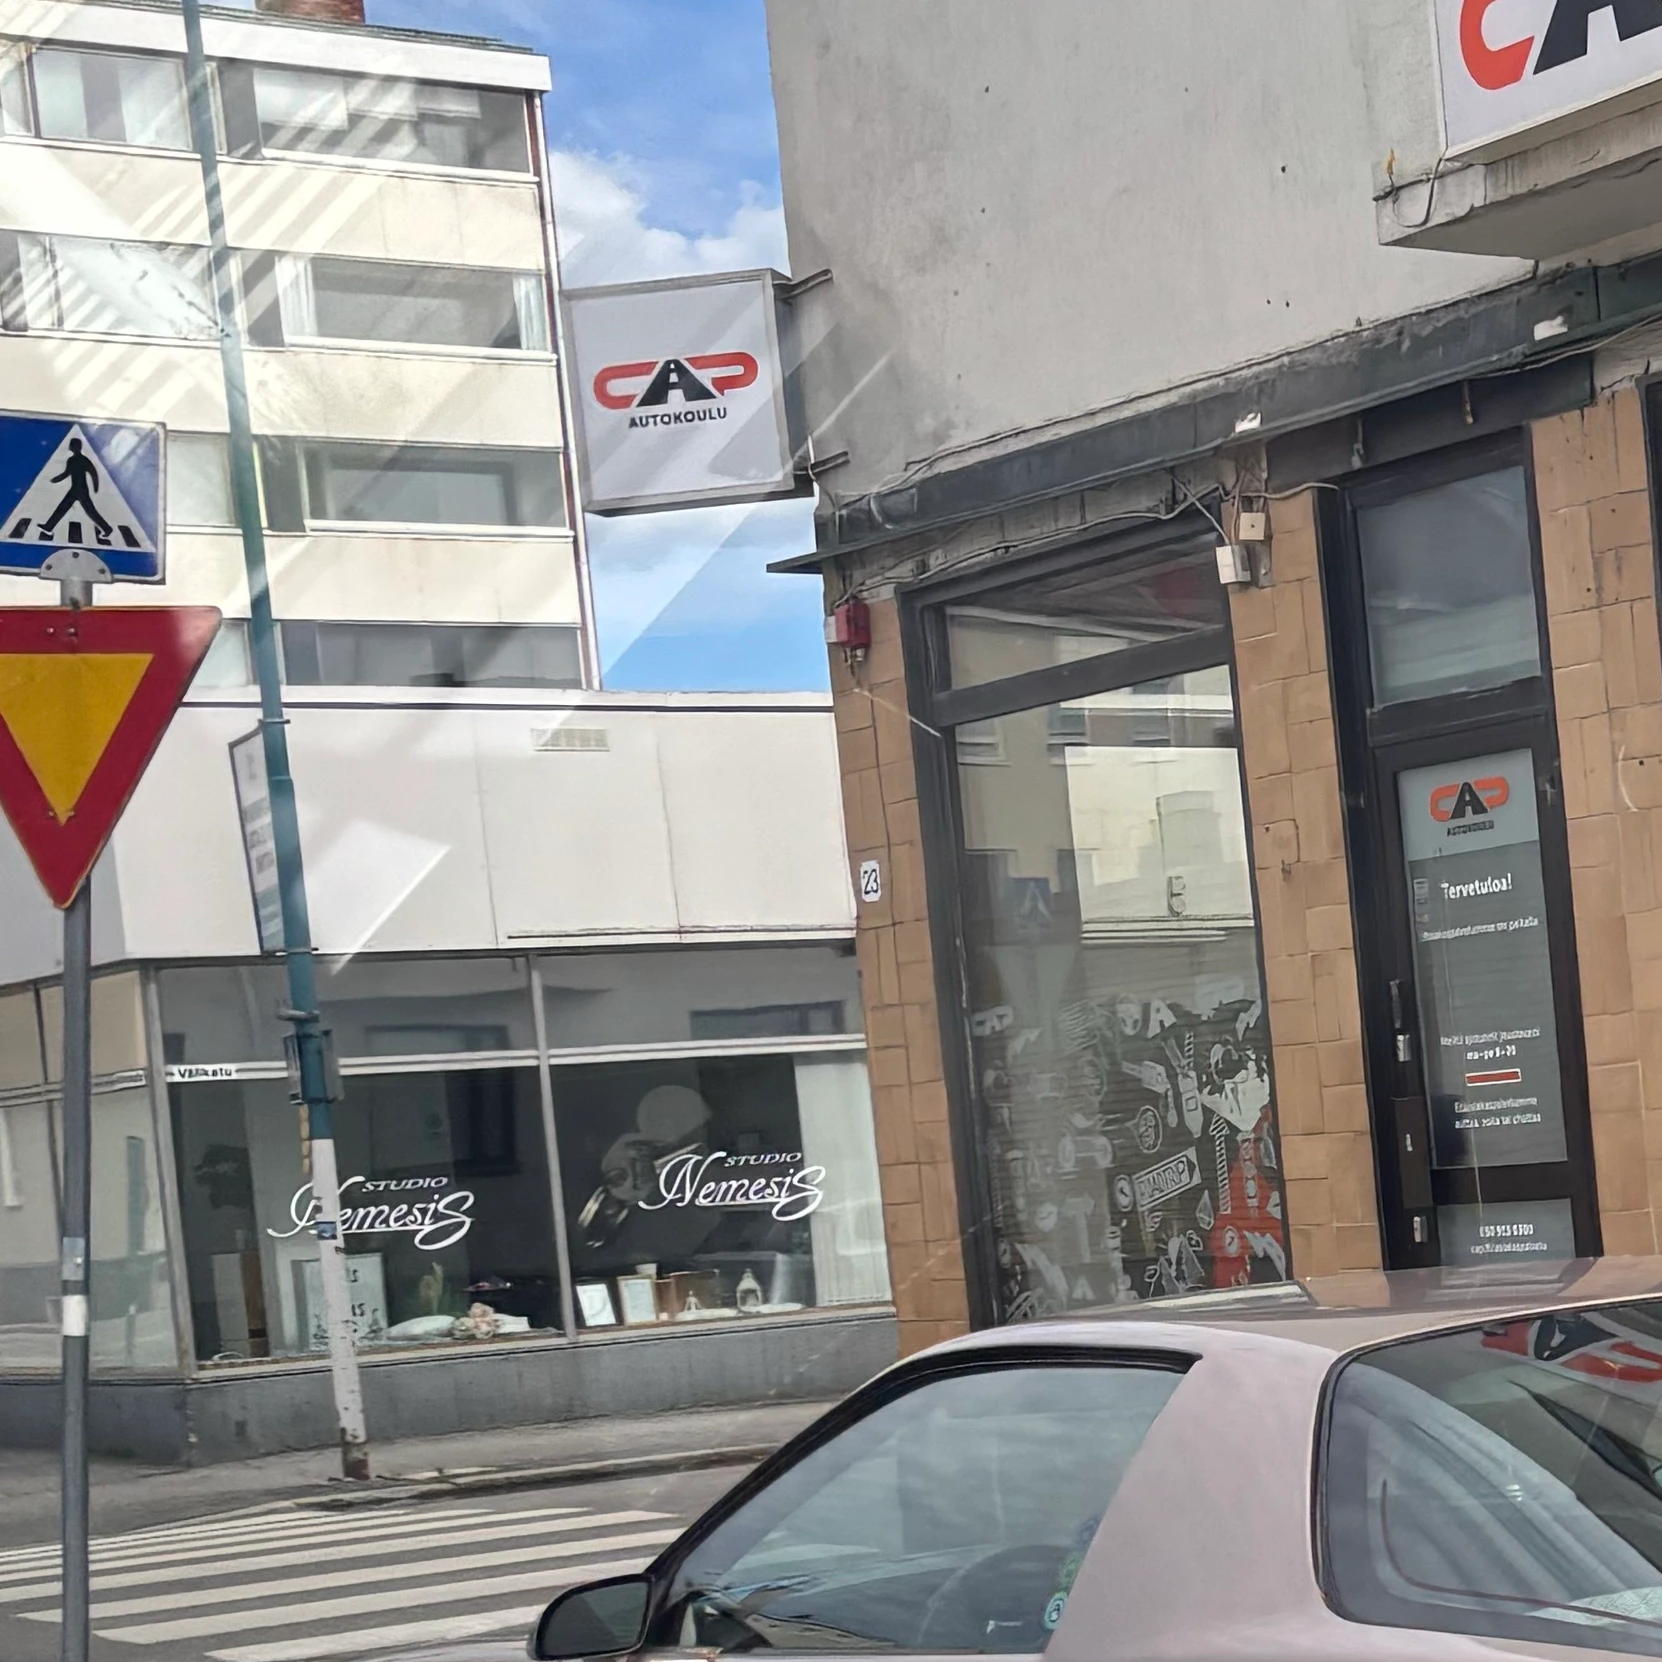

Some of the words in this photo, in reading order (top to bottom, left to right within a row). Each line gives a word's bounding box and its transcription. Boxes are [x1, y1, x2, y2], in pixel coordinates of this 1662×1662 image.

[593, 352, 758, 410] CAP
[628, 407, 727, 429] AUTOKOULU
[1430, 776, 1510, 823] CAP
[863, 868, 879, 895] 23
[723, 1152, 802, 1168] STUDIO
[361, 1177, 448, 1192] STUDIO
